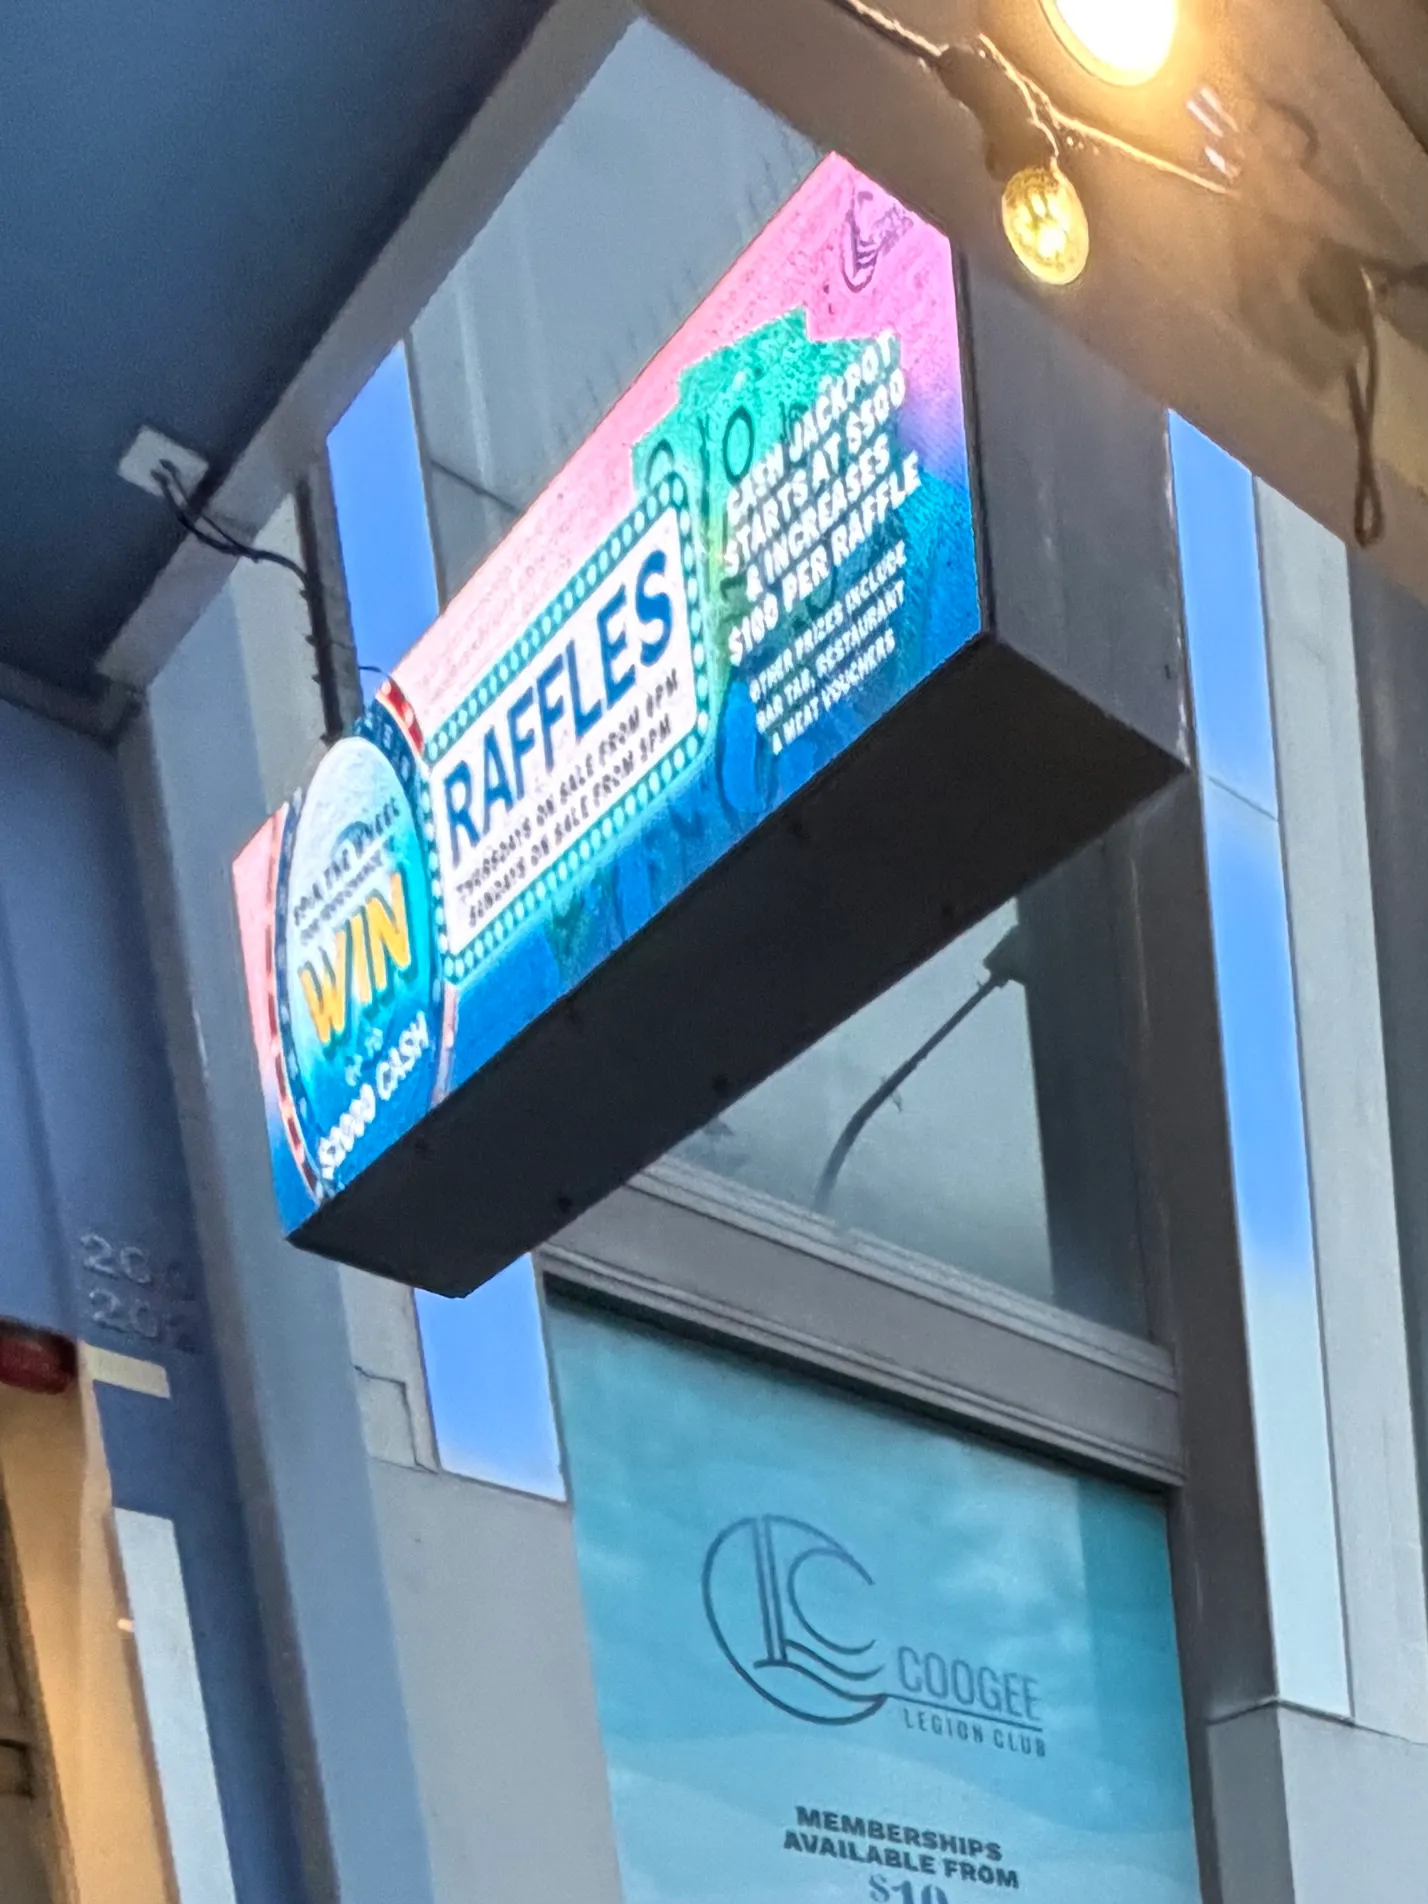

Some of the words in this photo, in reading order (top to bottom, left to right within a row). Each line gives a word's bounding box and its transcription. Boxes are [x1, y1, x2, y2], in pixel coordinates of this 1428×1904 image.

[726, 442, 784, 525] CASH
[788, 328, 896, 462] JACKPOT
[723, 469, 808, 577] STARTS
[812, 432, 841, 493] AT
[764, 433, 891, 584] INCREASES
[781, 544, 830, 612] PER
[831, 451, 922, 567] RAFFLE
[443, 549, 674, 870] RAFFLES
[299, 872, 412, 1044] WIN
[898, 1645, 1044, 1723] COOGEE
[902, 1707, 986, 1746] LEGION
[993, 1727, 1047, 1758] CLUB
[783, 1831, 937, 1876] AVAILABLE
[943, 1858, 1020, 1890] FROM
[795, 1805, 1004, 1861] MEMBERSHIPS
